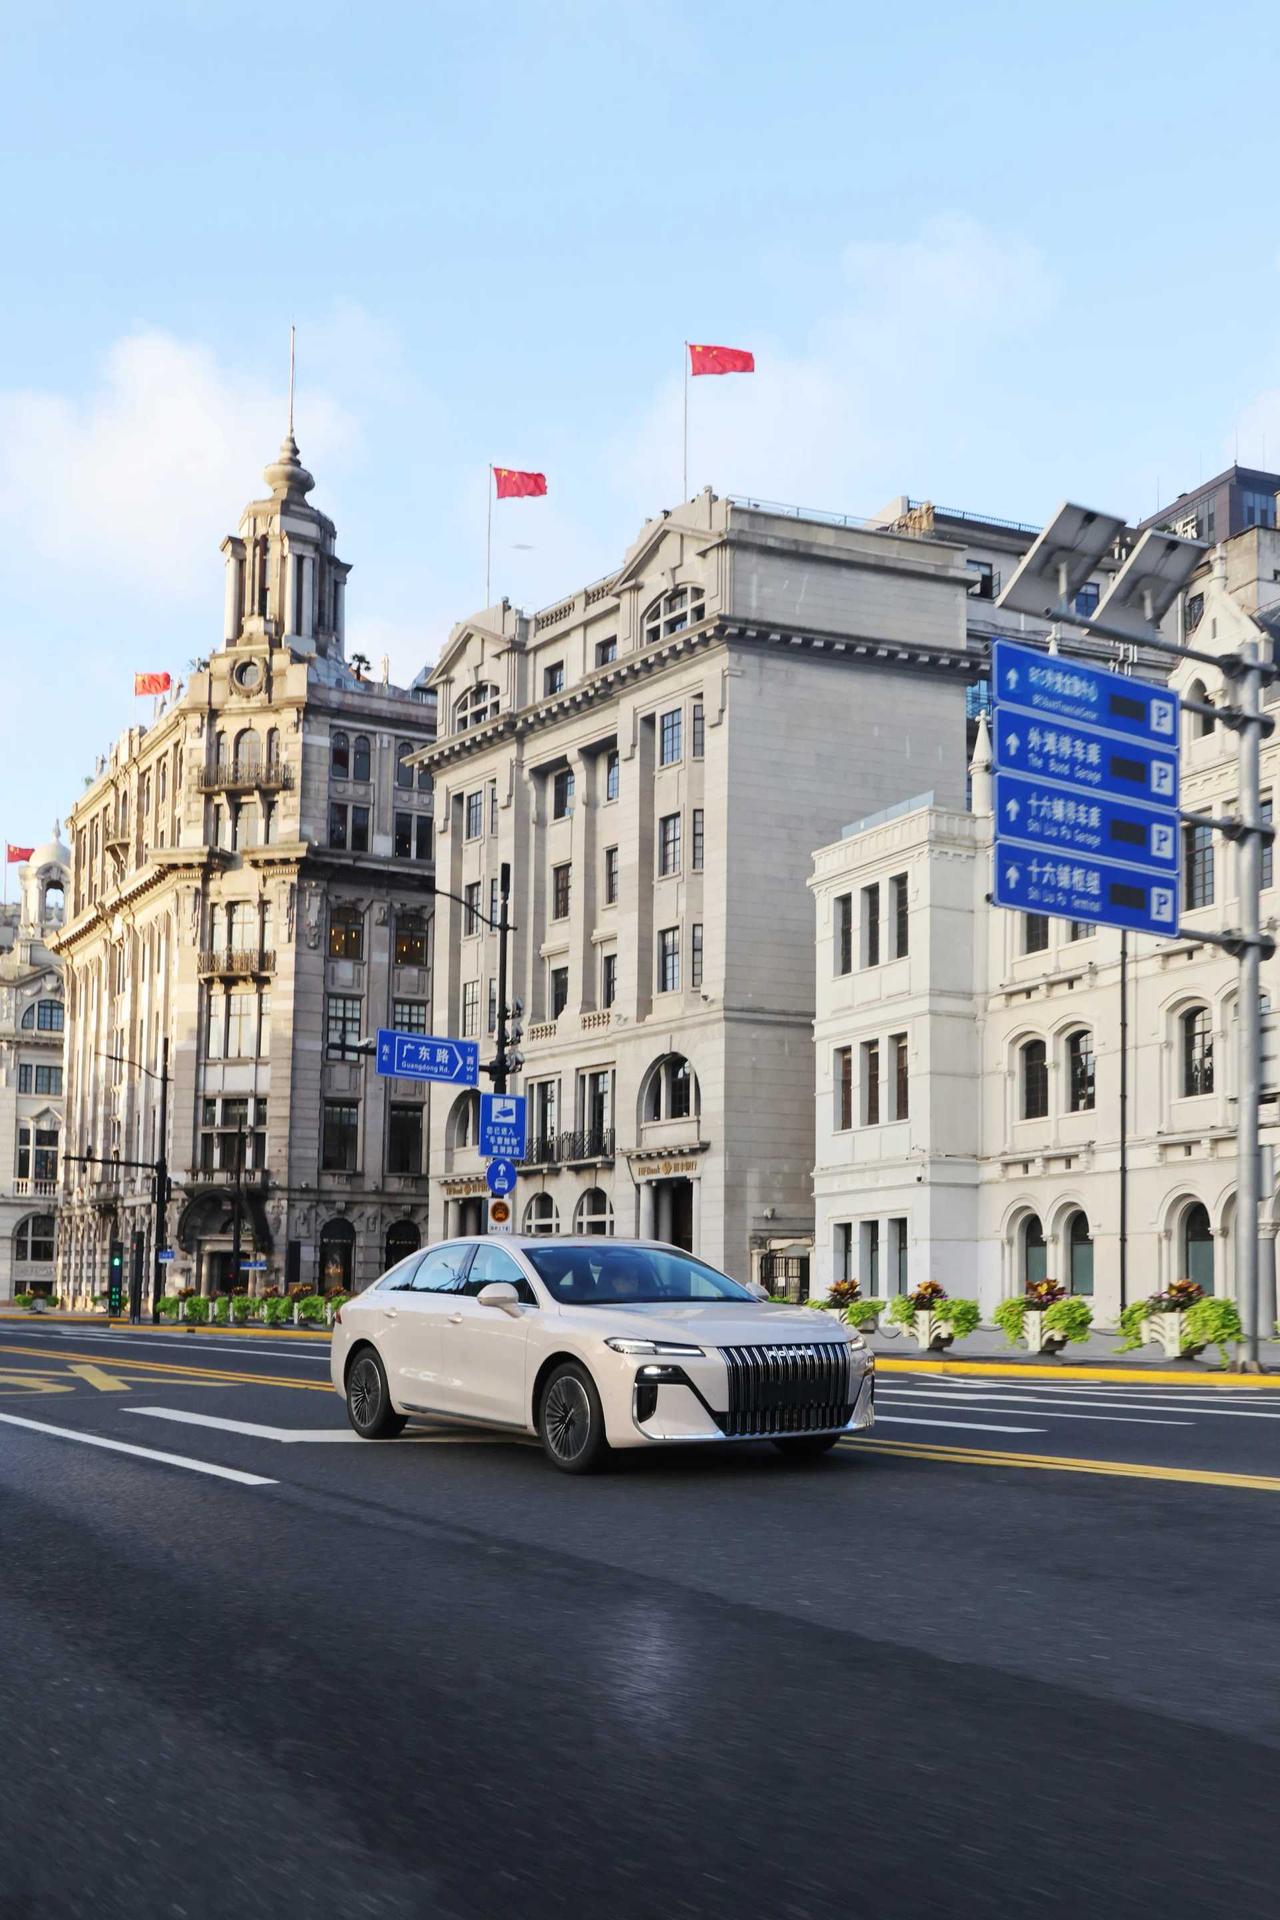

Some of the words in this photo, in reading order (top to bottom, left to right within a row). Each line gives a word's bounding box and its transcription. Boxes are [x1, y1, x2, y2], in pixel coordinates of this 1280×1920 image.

[1157, 767, 1168, 788] P
[1157, 829, 1168, 852] P
[1156, 893, 1168, 915] P
[402, 1043, 449, 1065] 广东路
[402, 1061, 438, 1073] Guangdong
